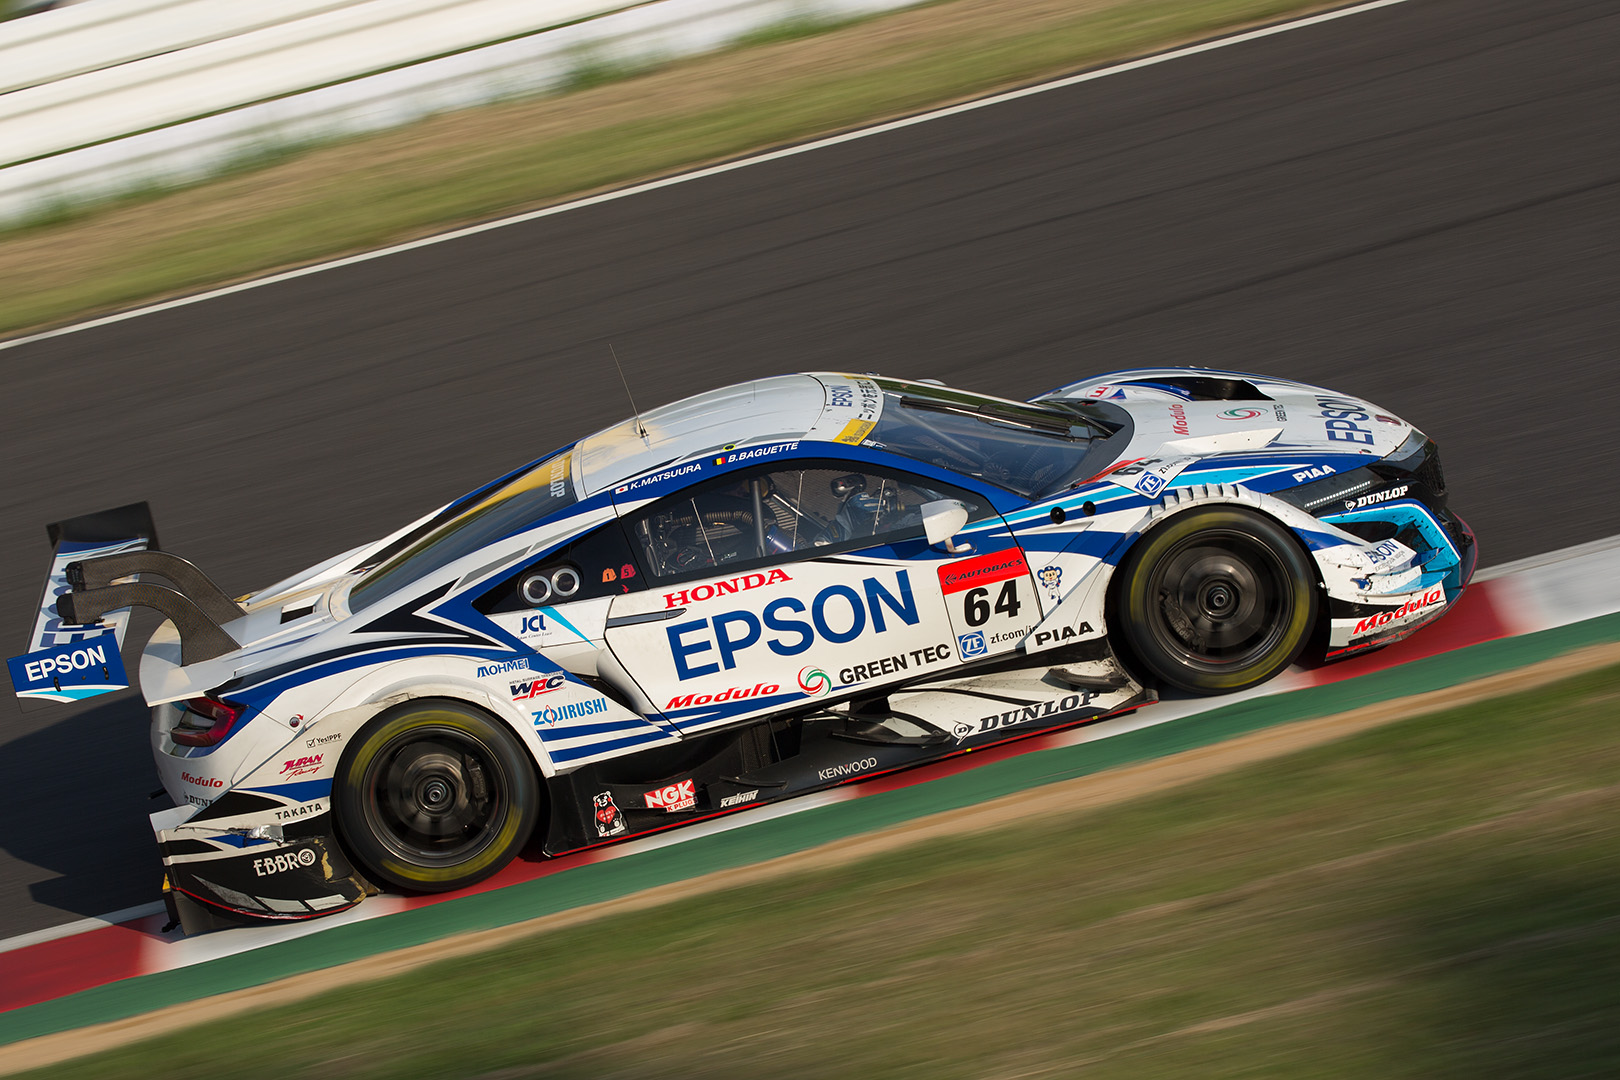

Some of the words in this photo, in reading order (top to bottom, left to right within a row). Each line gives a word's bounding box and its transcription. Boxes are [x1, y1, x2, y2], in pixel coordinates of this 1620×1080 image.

[1168, 404, 1190, 436] Modulo
[1314, 394, 1375, 446] EPSON
[728, 441, 800, 464] B.BAGUETTE
[630, 463, 702, 490] K.MATSUURA
[1292, 464, 1336, 483] PIAA
[1357, 485, 1409, 509] DUNLOP
[958, 558, 1023, 581] AUTOBACS
[663, 568, 793, 609] HONDA
[964, 579, 1021, 627] 64
[1353, 590, 1441, 635] Modulo
[666, 569, 920, 682] EPSON
[1035, 621, 1095, 646] PIAA
[24, 645, 107, 682] EPSON
[477, 658, 528, 678] MOHMEI
[839, 655, 907, 685] GREEN
[909, 643, 951, 668] TEC
[665, 682, 780, 710] Modulo
[531, 697, 608, 727] ZOJIRUSHI
[978, 692, 1100, 733] DUNLOP
[181, 771, 224, 788] Modulo
[818, 757, 878, 781] KENWOOD
[189, 794, 213, 807] DUN
[645, 780, 695, 808] NGK
[275, 803, 322, 820] TAKATA
[254, 848, 316, 877] EBBRO
